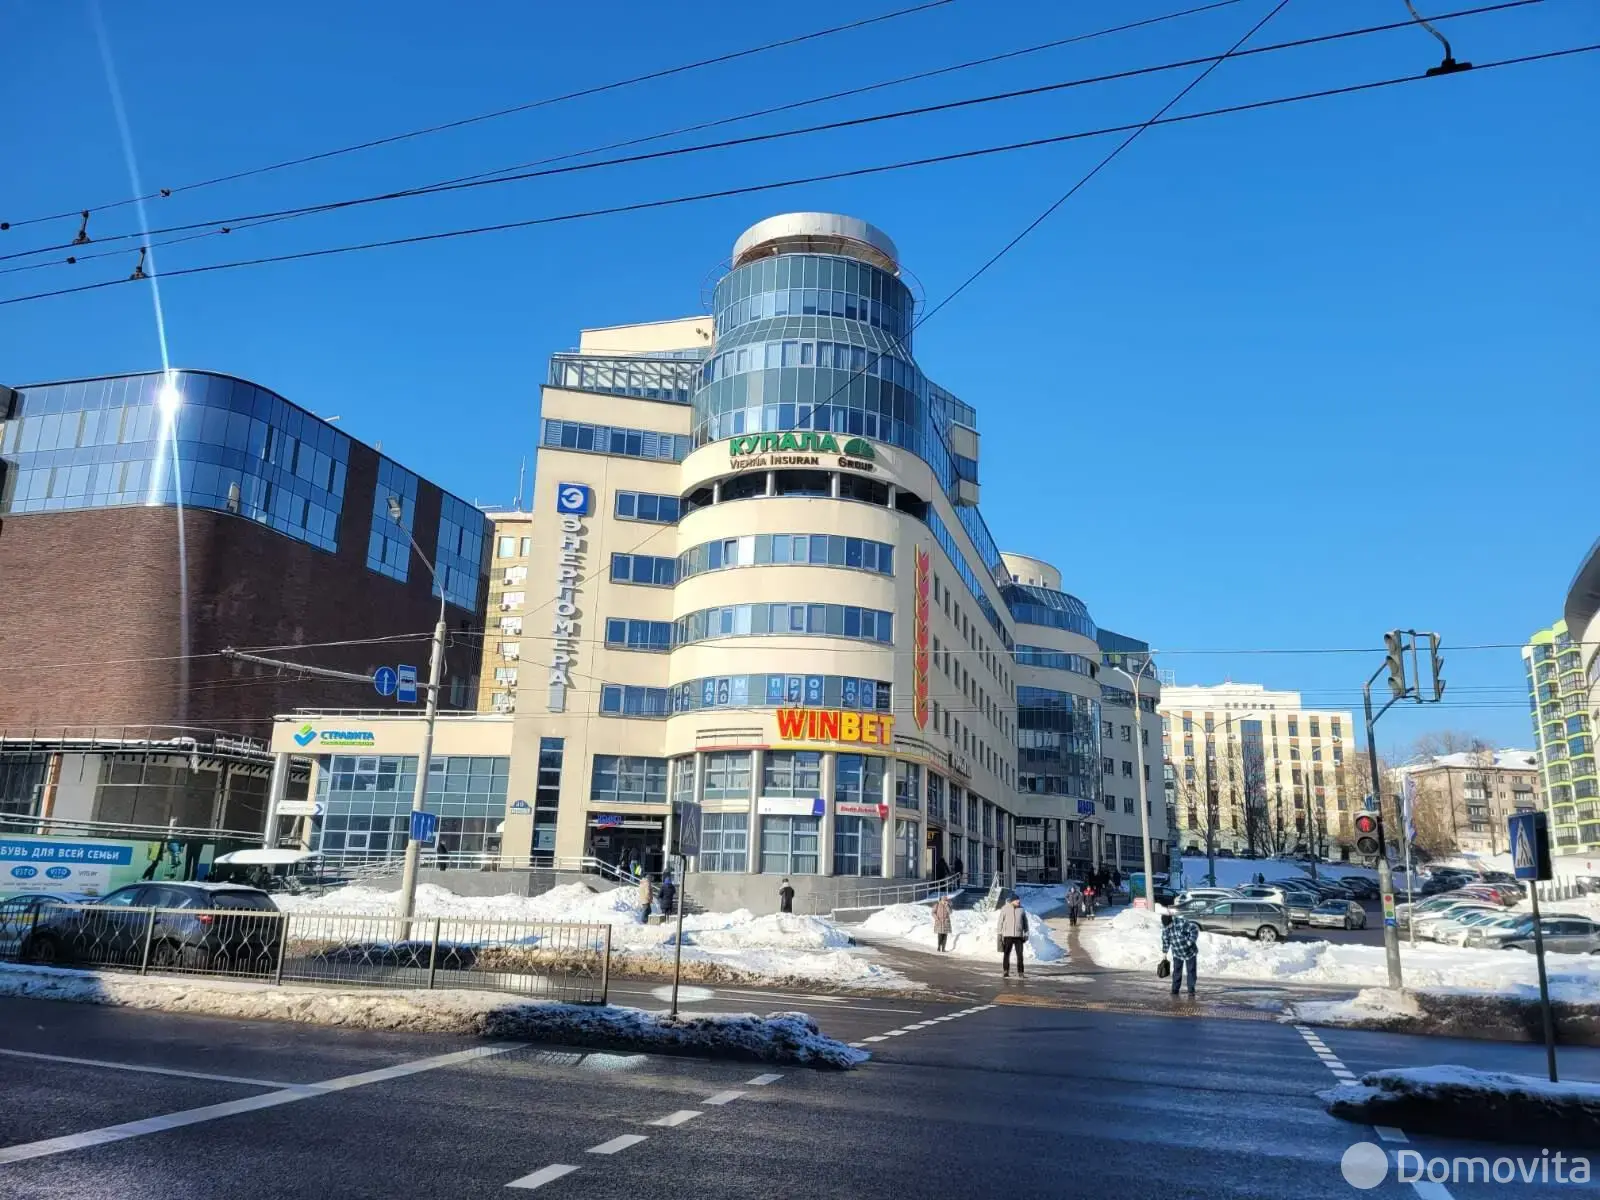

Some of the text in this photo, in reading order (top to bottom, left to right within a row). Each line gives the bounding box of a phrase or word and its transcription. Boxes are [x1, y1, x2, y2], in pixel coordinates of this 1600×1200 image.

[729, 432, 841, 456] КУПАЛА
[549, 513, 582, 687] ЭНЕРГОМЕРА
[320, 731, 375, 741] СТРАВИТА
[776, 708, 895, 746] WINBET
[31, 848, 54, 858] ДЛЯ
[58, 848, 84, 858] ВСЕЙ
[87, 850, 119, 860] СЕМЬИ
